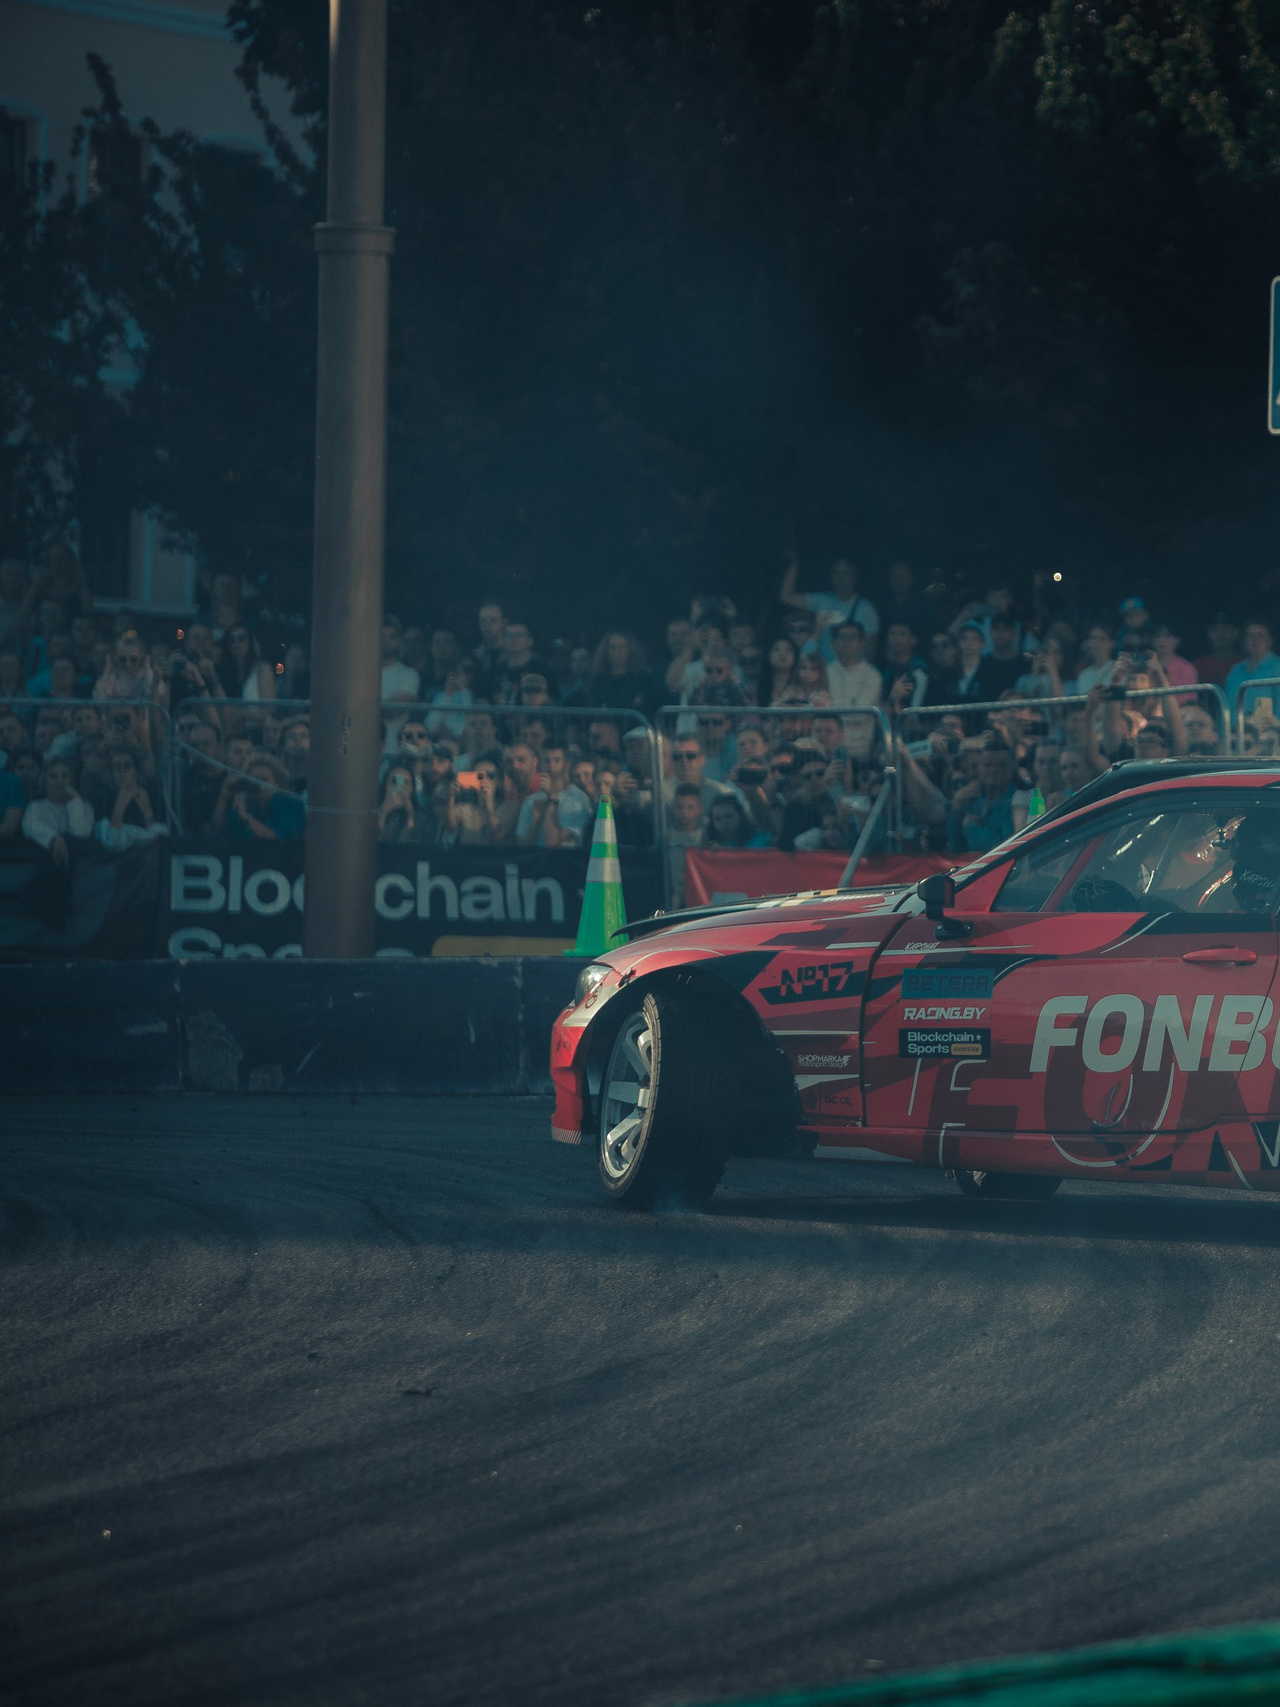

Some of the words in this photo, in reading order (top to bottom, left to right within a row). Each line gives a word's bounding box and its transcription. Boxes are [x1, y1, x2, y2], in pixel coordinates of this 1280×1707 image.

[907, 1031, 975, 1043] Blockchain
[907, 1043, 950, 1056] Sports
[797, 1054, 843, 1063] SHOPMARKA
